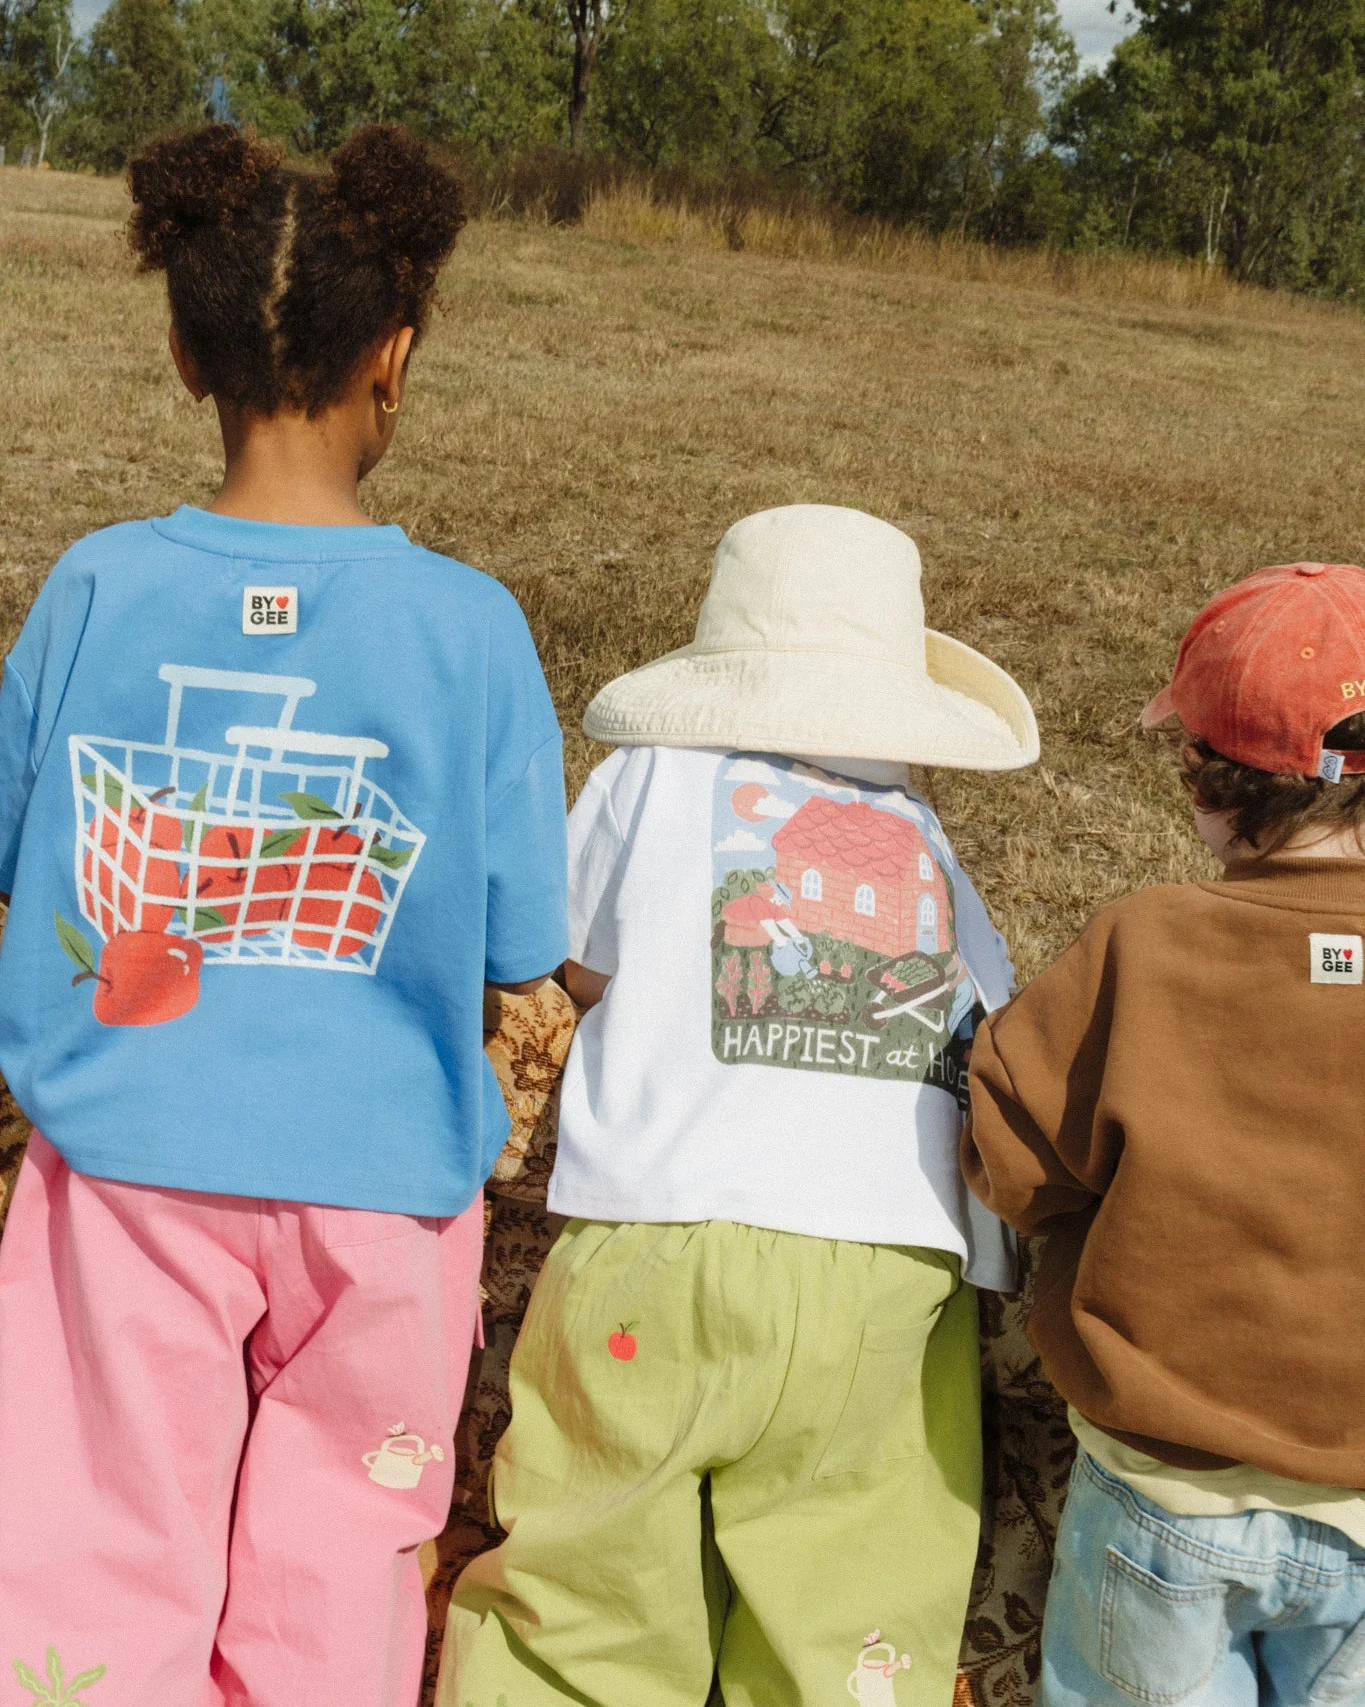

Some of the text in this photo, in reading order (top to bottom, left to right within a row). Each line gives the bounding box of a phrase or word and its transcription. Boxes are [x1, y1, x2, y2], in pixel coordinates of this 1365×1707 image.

[251, 595, 275, 610] BY
[250, 611, 289, 625] GEE
[1341, 680, 1365, 699] BY
[1322, 947, 1342, 960] BY
[1322, 960, 1353, 973] GEE
[723, 1023, 881, 1068] HAPPIEST
[886, 1044, 919, 1069] at
